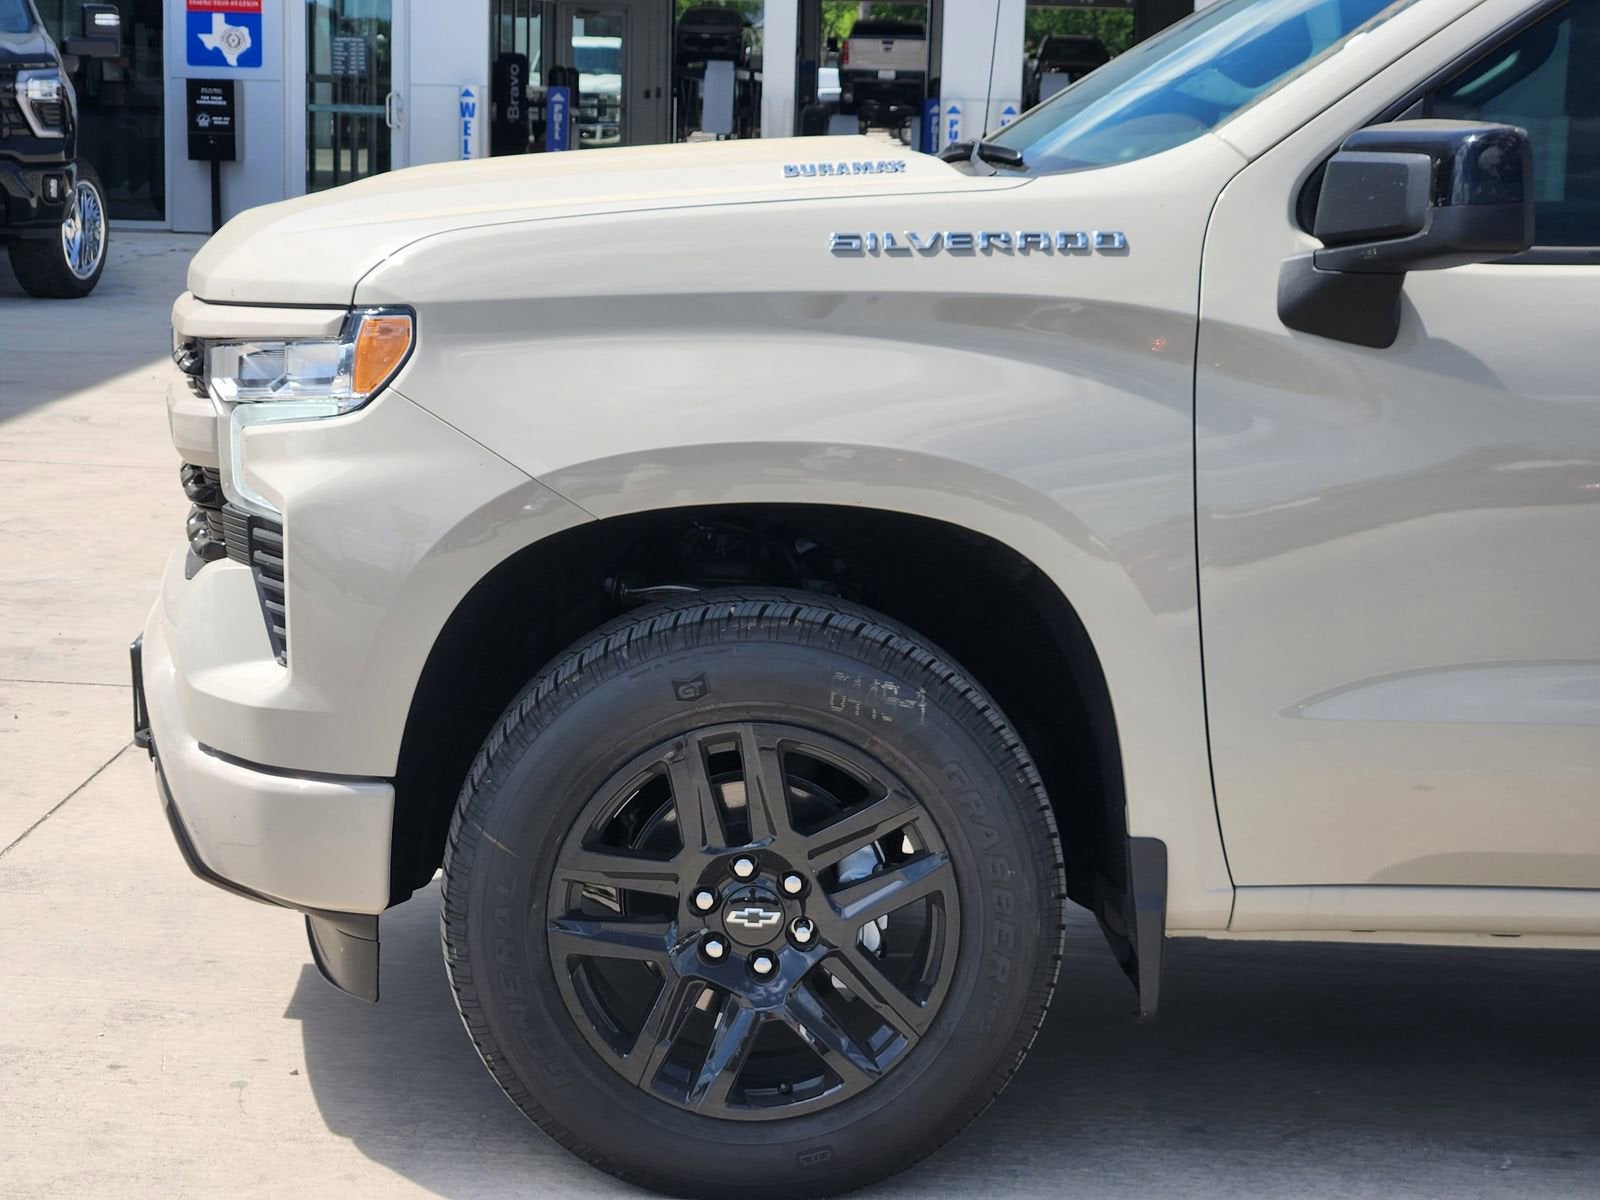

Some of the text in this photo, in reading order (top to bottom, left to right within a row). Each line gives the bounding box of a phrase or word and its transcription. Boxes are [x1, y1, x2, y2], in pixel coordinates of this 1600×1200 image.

[507, 63, 520, 119] Bravo
[460, 102, 476, 160] WEL
[783, 160, 907, 178] DURAMAX
[829, 229, 1128, 253] SILVERADO
[943, 760, 1016, 985] GRABBER
